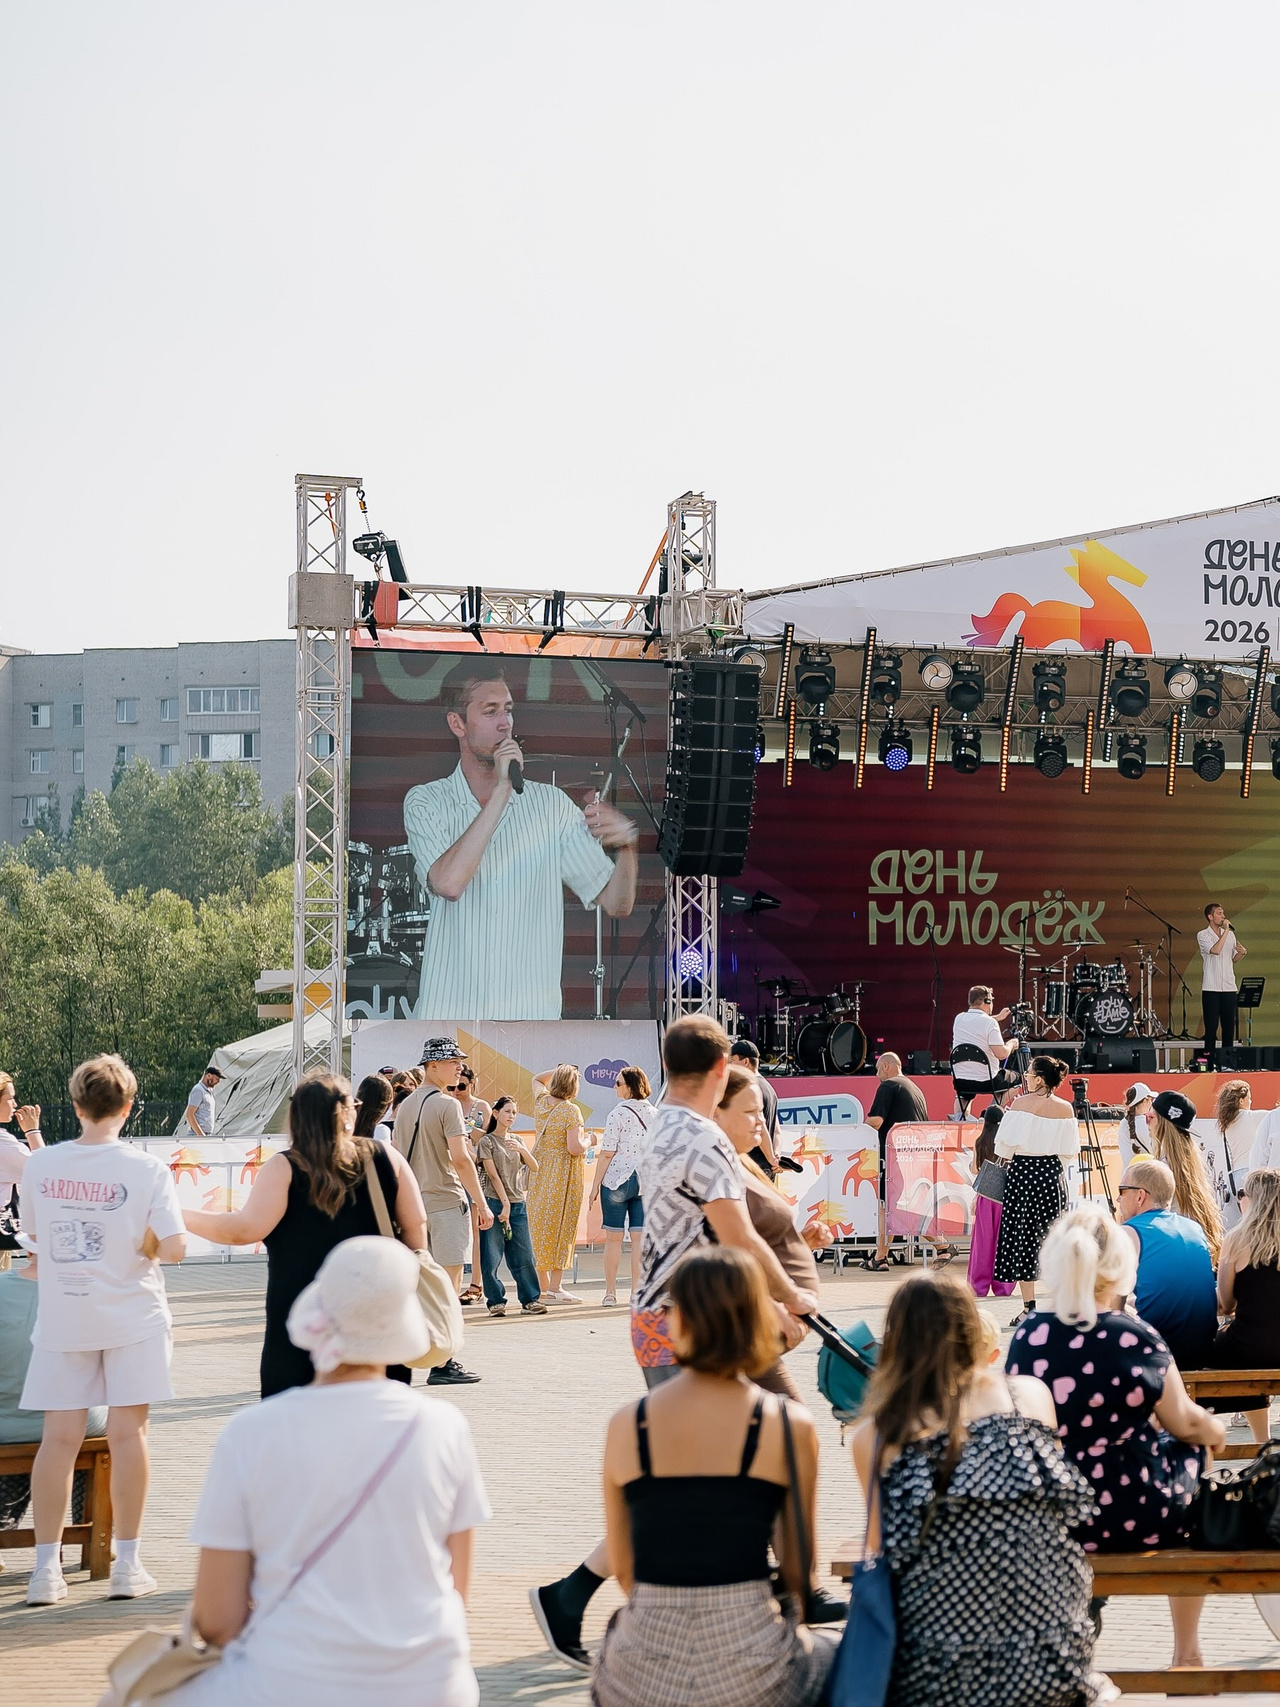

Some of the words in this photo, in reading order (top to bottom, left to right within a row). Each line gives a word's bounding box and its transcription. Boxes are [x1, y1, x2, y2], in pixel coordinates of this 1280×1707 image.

[1204, 619, 1270, 644] 2026
[868, 849, 999, 895] ДЕНЬ
[868, 890, 1106, 945] МОЛОДЁЖ
[41, 1178, 118, 1203] SARDINHAS
